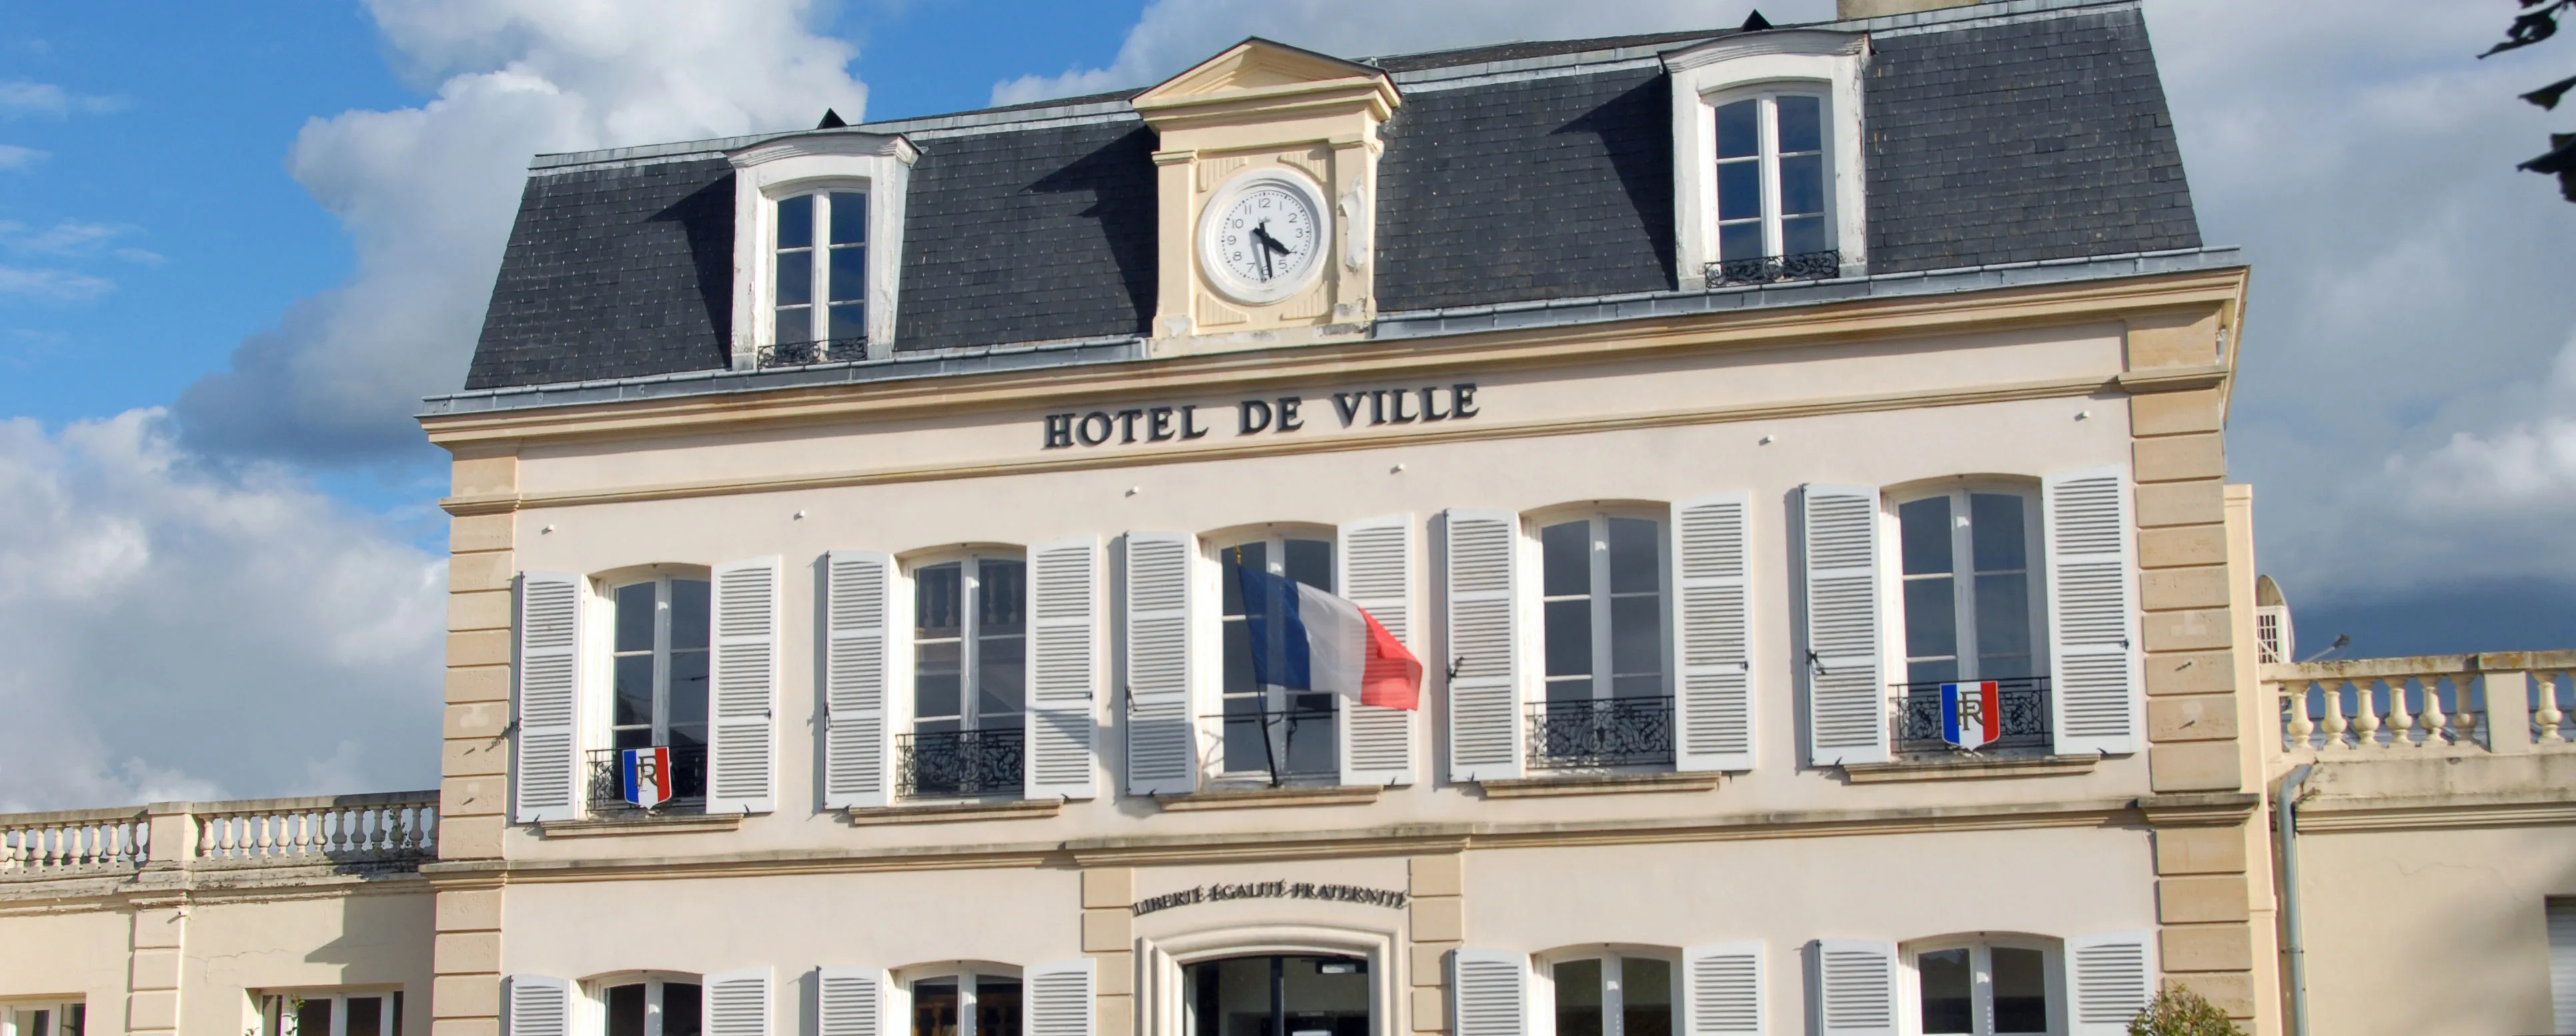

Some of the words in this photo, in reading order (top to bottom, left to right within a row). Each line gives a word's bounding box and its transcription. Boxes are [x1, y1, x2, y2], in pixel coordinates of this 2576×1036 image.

[1258, 198, 1271, 208] 12
[1244, 205, 1251, 215] 11
[1288, 213, 1297, 223] 2
[1232, 219, 1244, 229] 10
[1295, 229, 1303, 238] 3
[1227, 235, 1237, 245] 9
[1233, 251, 1242, 261] 8
[1247, 262, 1256, 272] 7
[1278, 259, 1287, 269] 5
[1041, 404, 1209, 450] HOTEL
[1229, 396, 1305, 436] DE
[1330, 382, 1480, 429] VILLE
